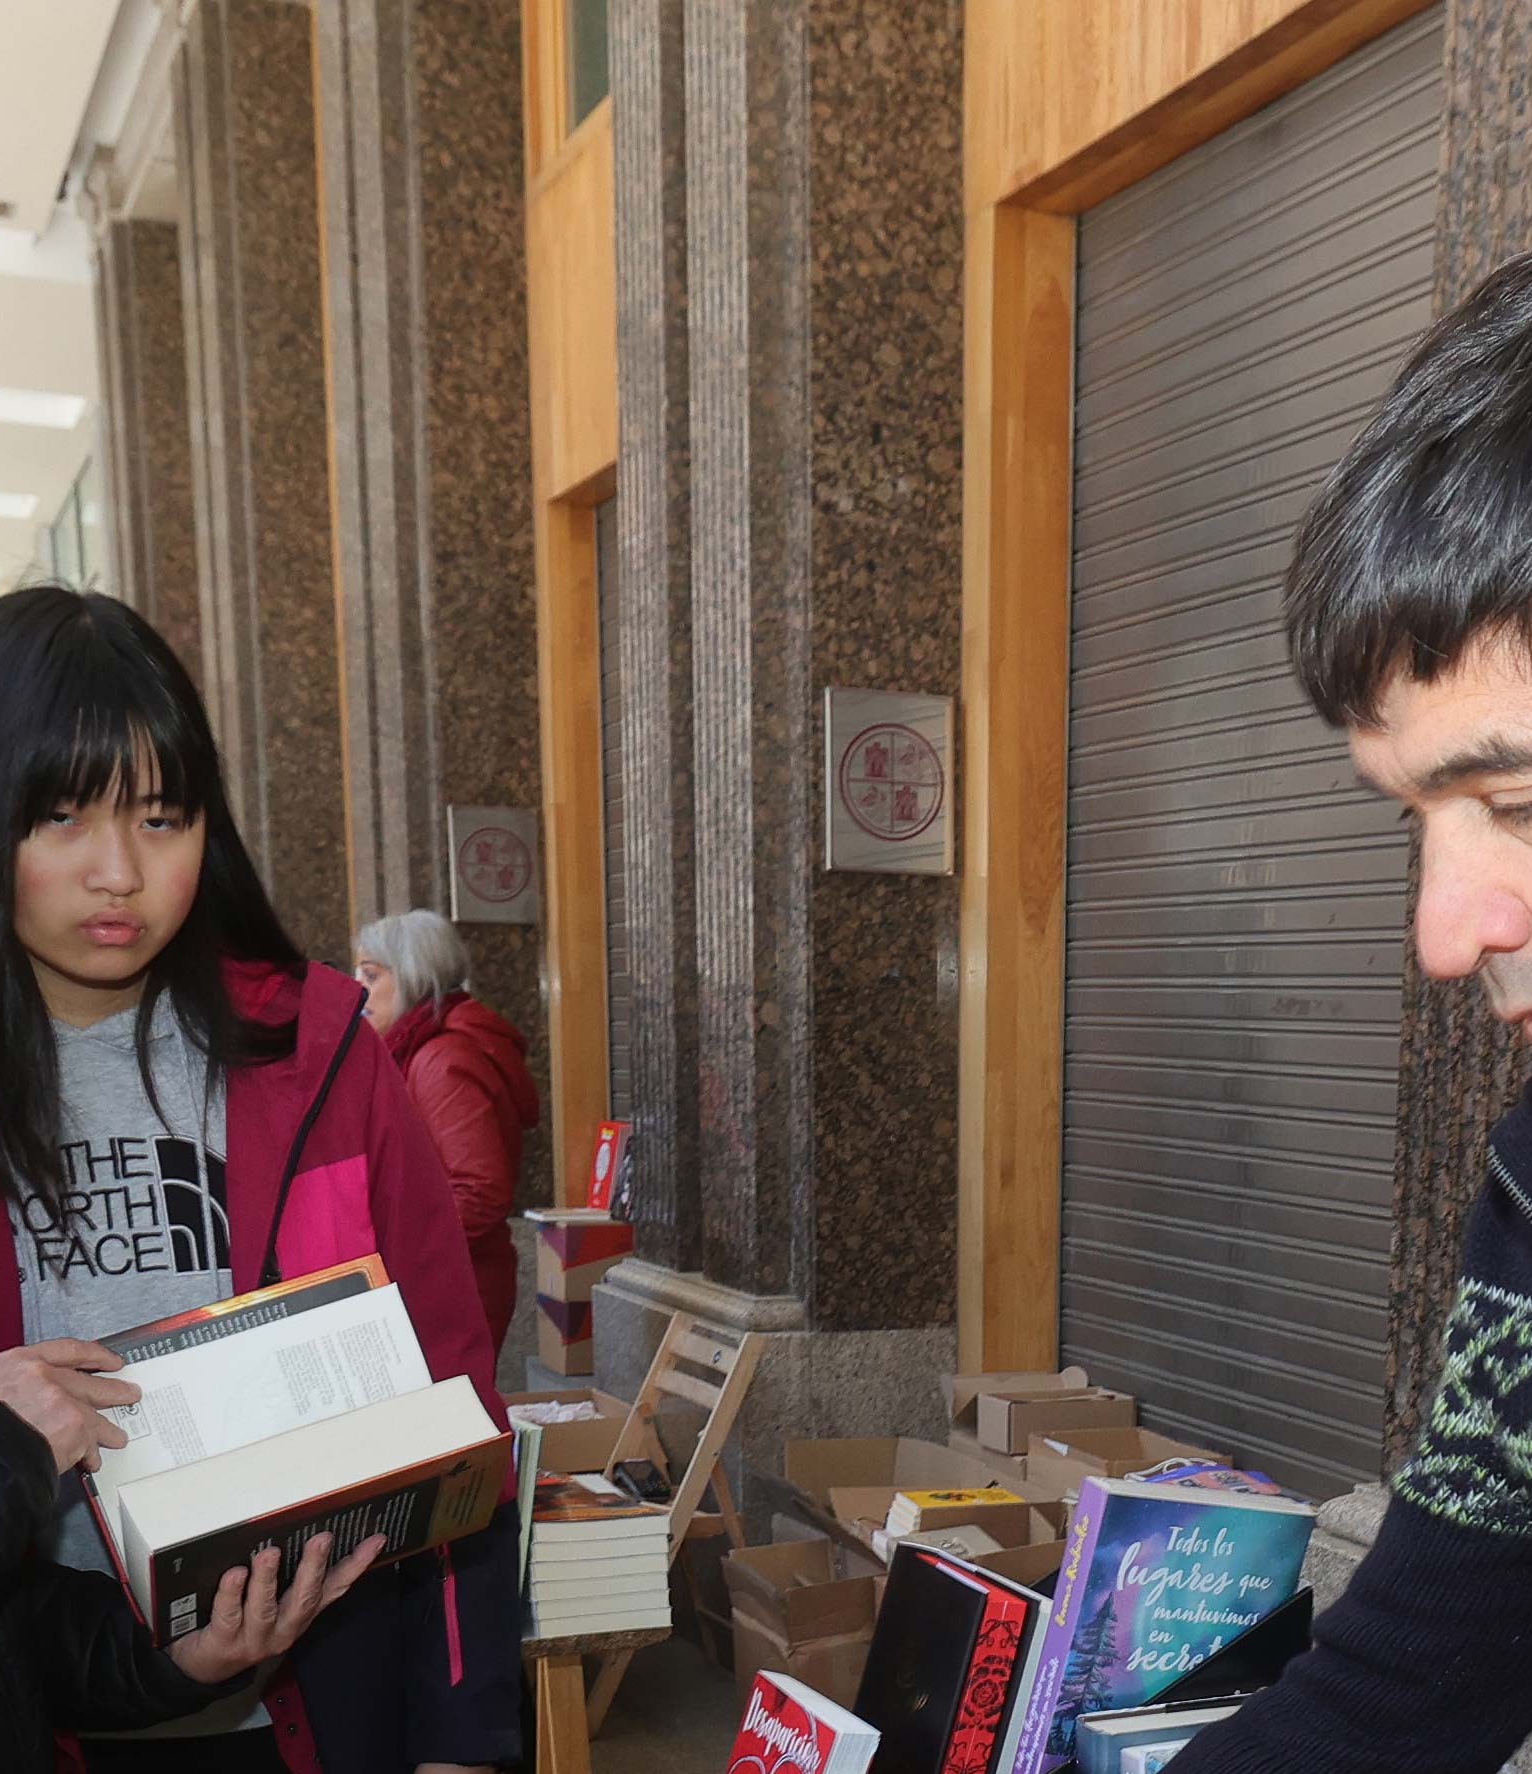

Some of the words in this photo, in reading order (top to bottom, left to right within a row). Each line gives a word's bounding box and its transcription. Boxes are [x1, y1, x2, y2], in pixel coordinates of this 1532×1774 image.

[61, 1137, 153, 1178] THE
[36, 1232, 169, 1282] FACE
[1166, 1526, 1209, 1556] Todos
[1212, 1527, 1235, 1557] los
[1117, 1541, 1234, 1607] lugares
[1239, 1573, 1273, 1599] que
[1153, 1599, 1261, 1627] mantuvimos
[1148, 1626, 1174, 1644] en
[742, 1686, 823, 1771] Desaparición
